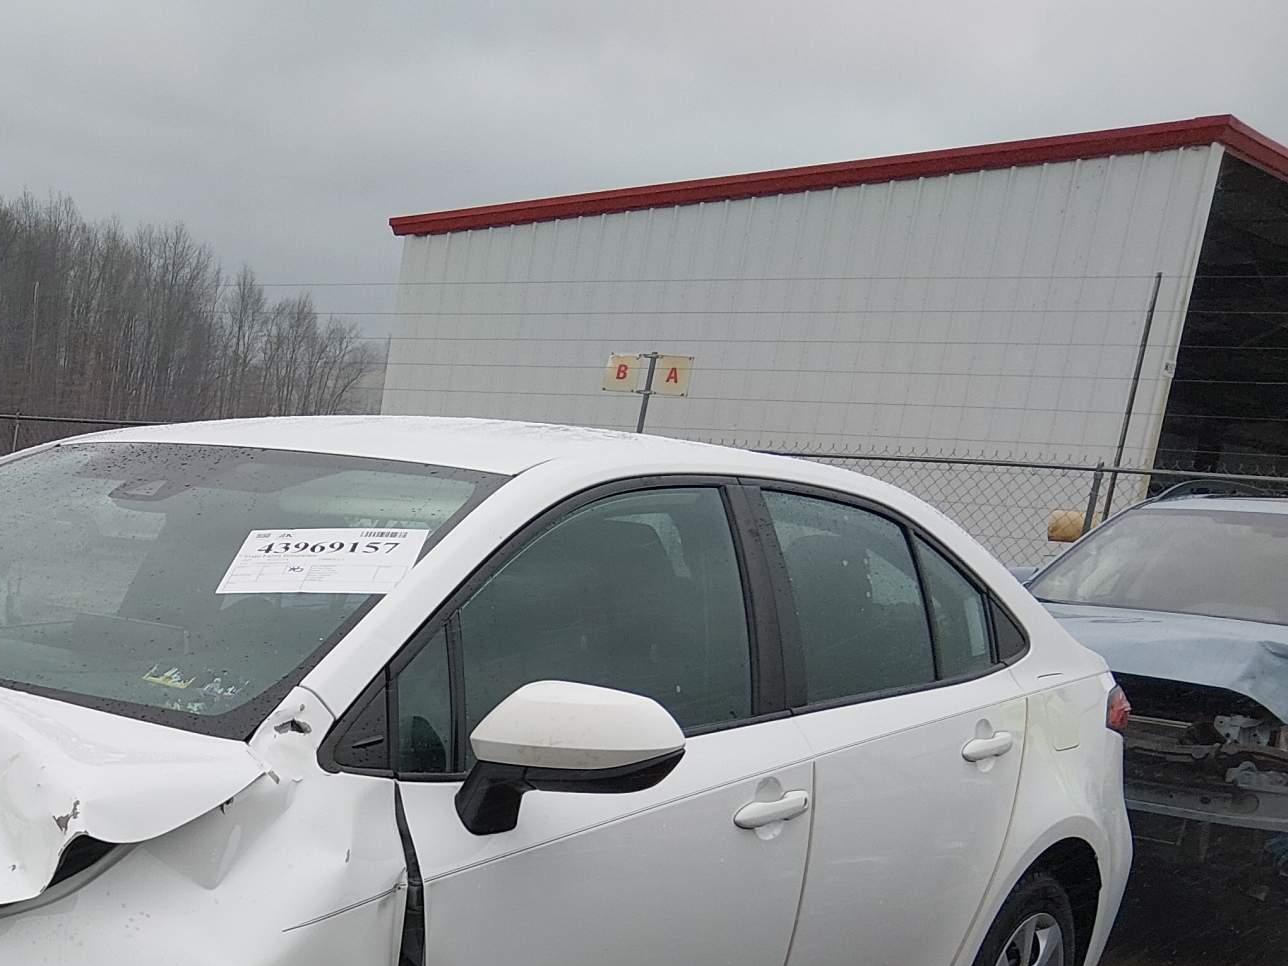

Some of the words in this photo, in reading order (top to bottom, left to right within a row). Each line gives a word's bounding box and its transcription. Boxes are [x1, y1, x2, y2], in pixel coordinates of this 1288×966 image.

[616, 364, 628, 380] B
[665, 367, 678, 384] A
[256, 541, 401, 555] 43969157
